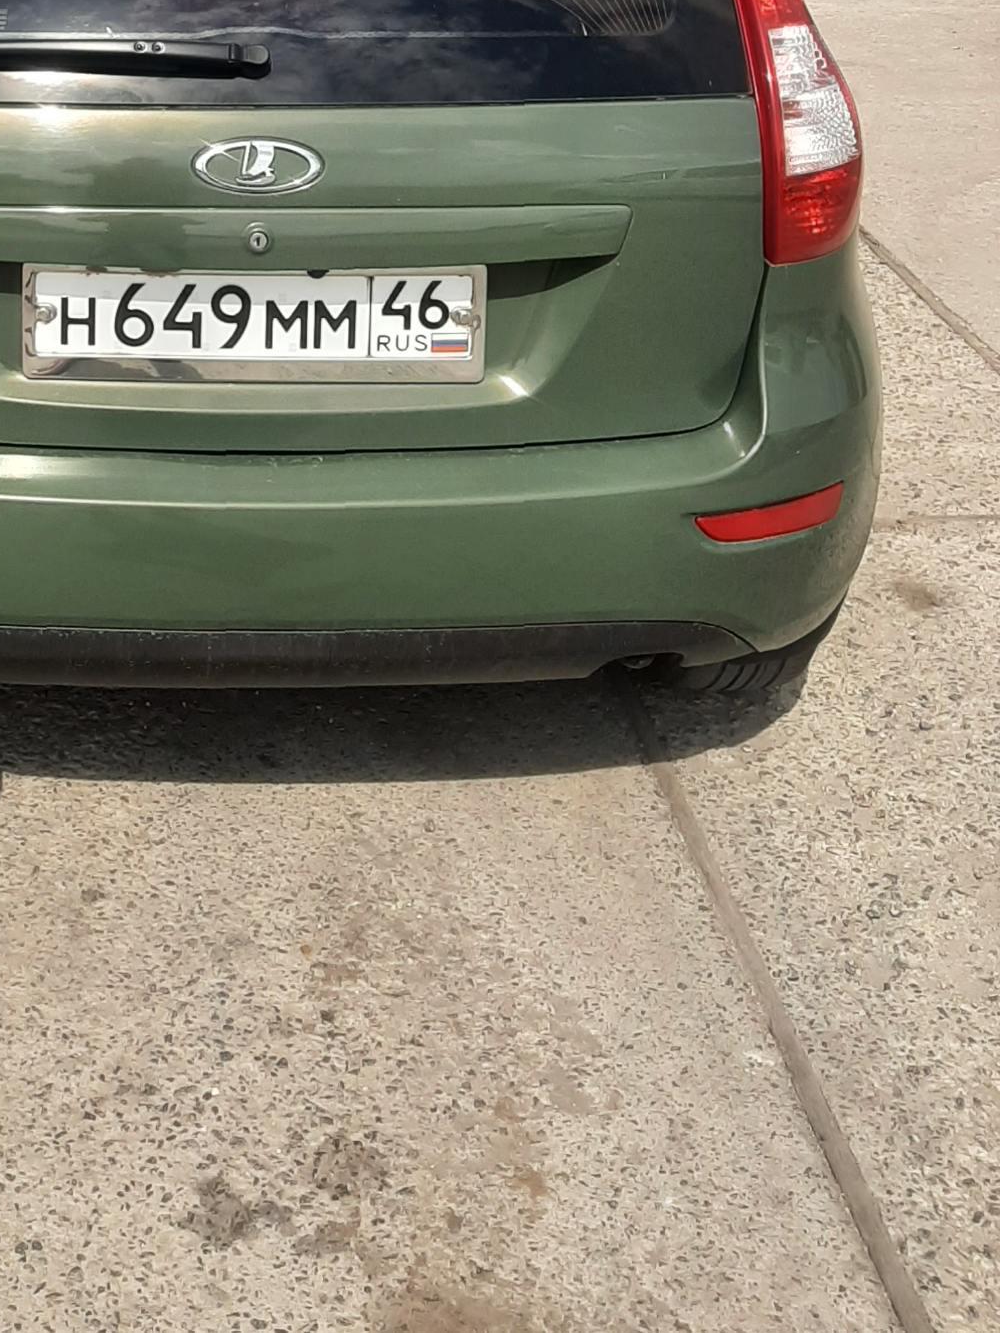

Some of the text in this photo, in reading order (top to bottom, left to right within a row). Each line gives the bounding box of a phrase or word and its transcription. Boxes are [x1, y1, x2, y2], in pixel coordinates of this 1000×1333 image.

[59, 280, 450, 349] Н649ММ 46
[376, 334, 428, 352] RUS
